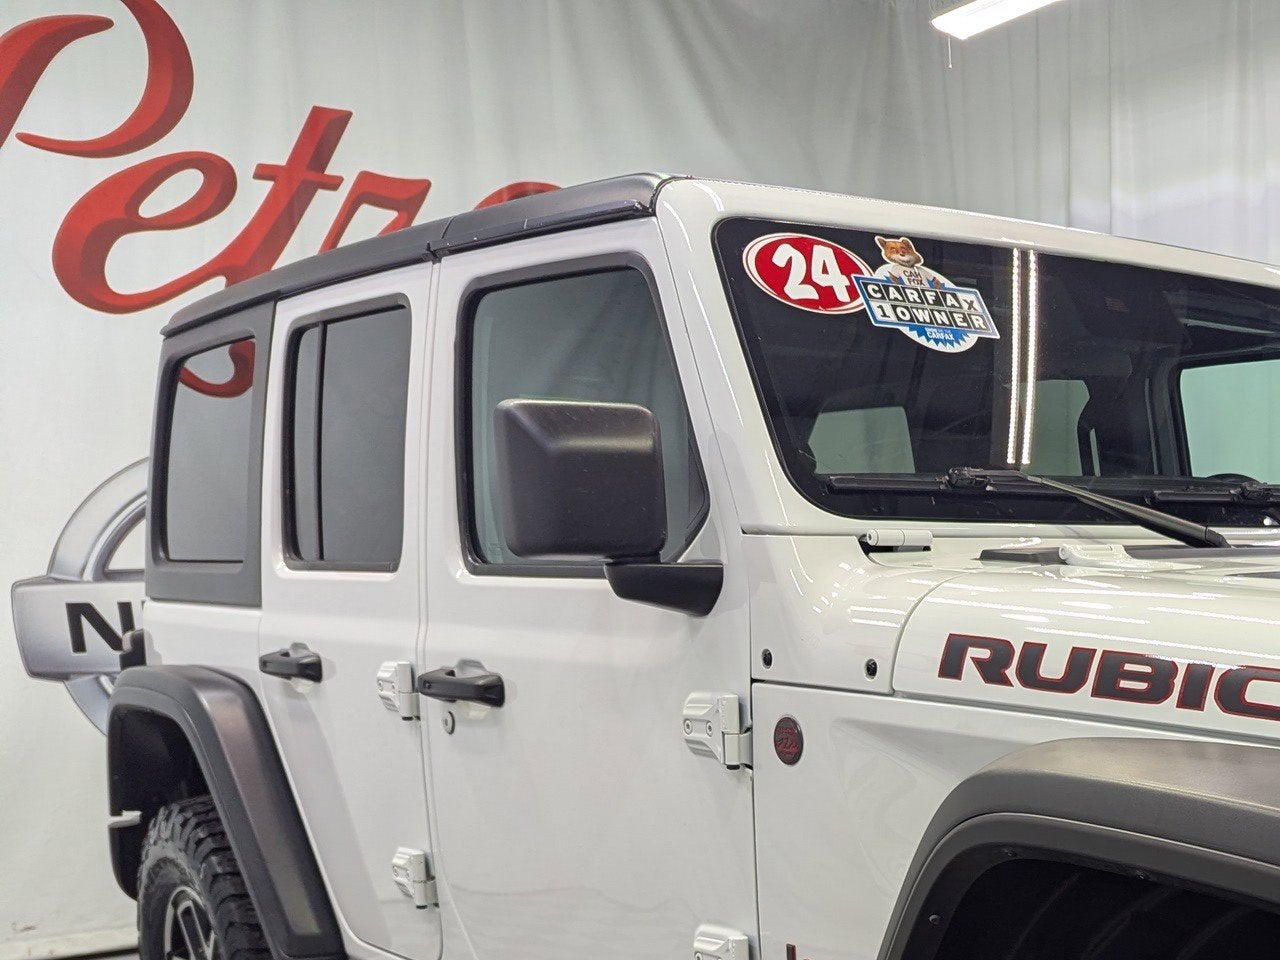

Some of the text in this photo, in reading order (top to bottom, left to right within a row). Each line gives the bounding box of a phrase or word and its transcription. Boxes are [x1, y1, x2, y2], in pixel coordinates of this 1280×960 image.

[771, 243, 850, 302] 24
[866, 283, 979, 312] CARFAX
[876, 304, 988, 330] 1 OWNER
